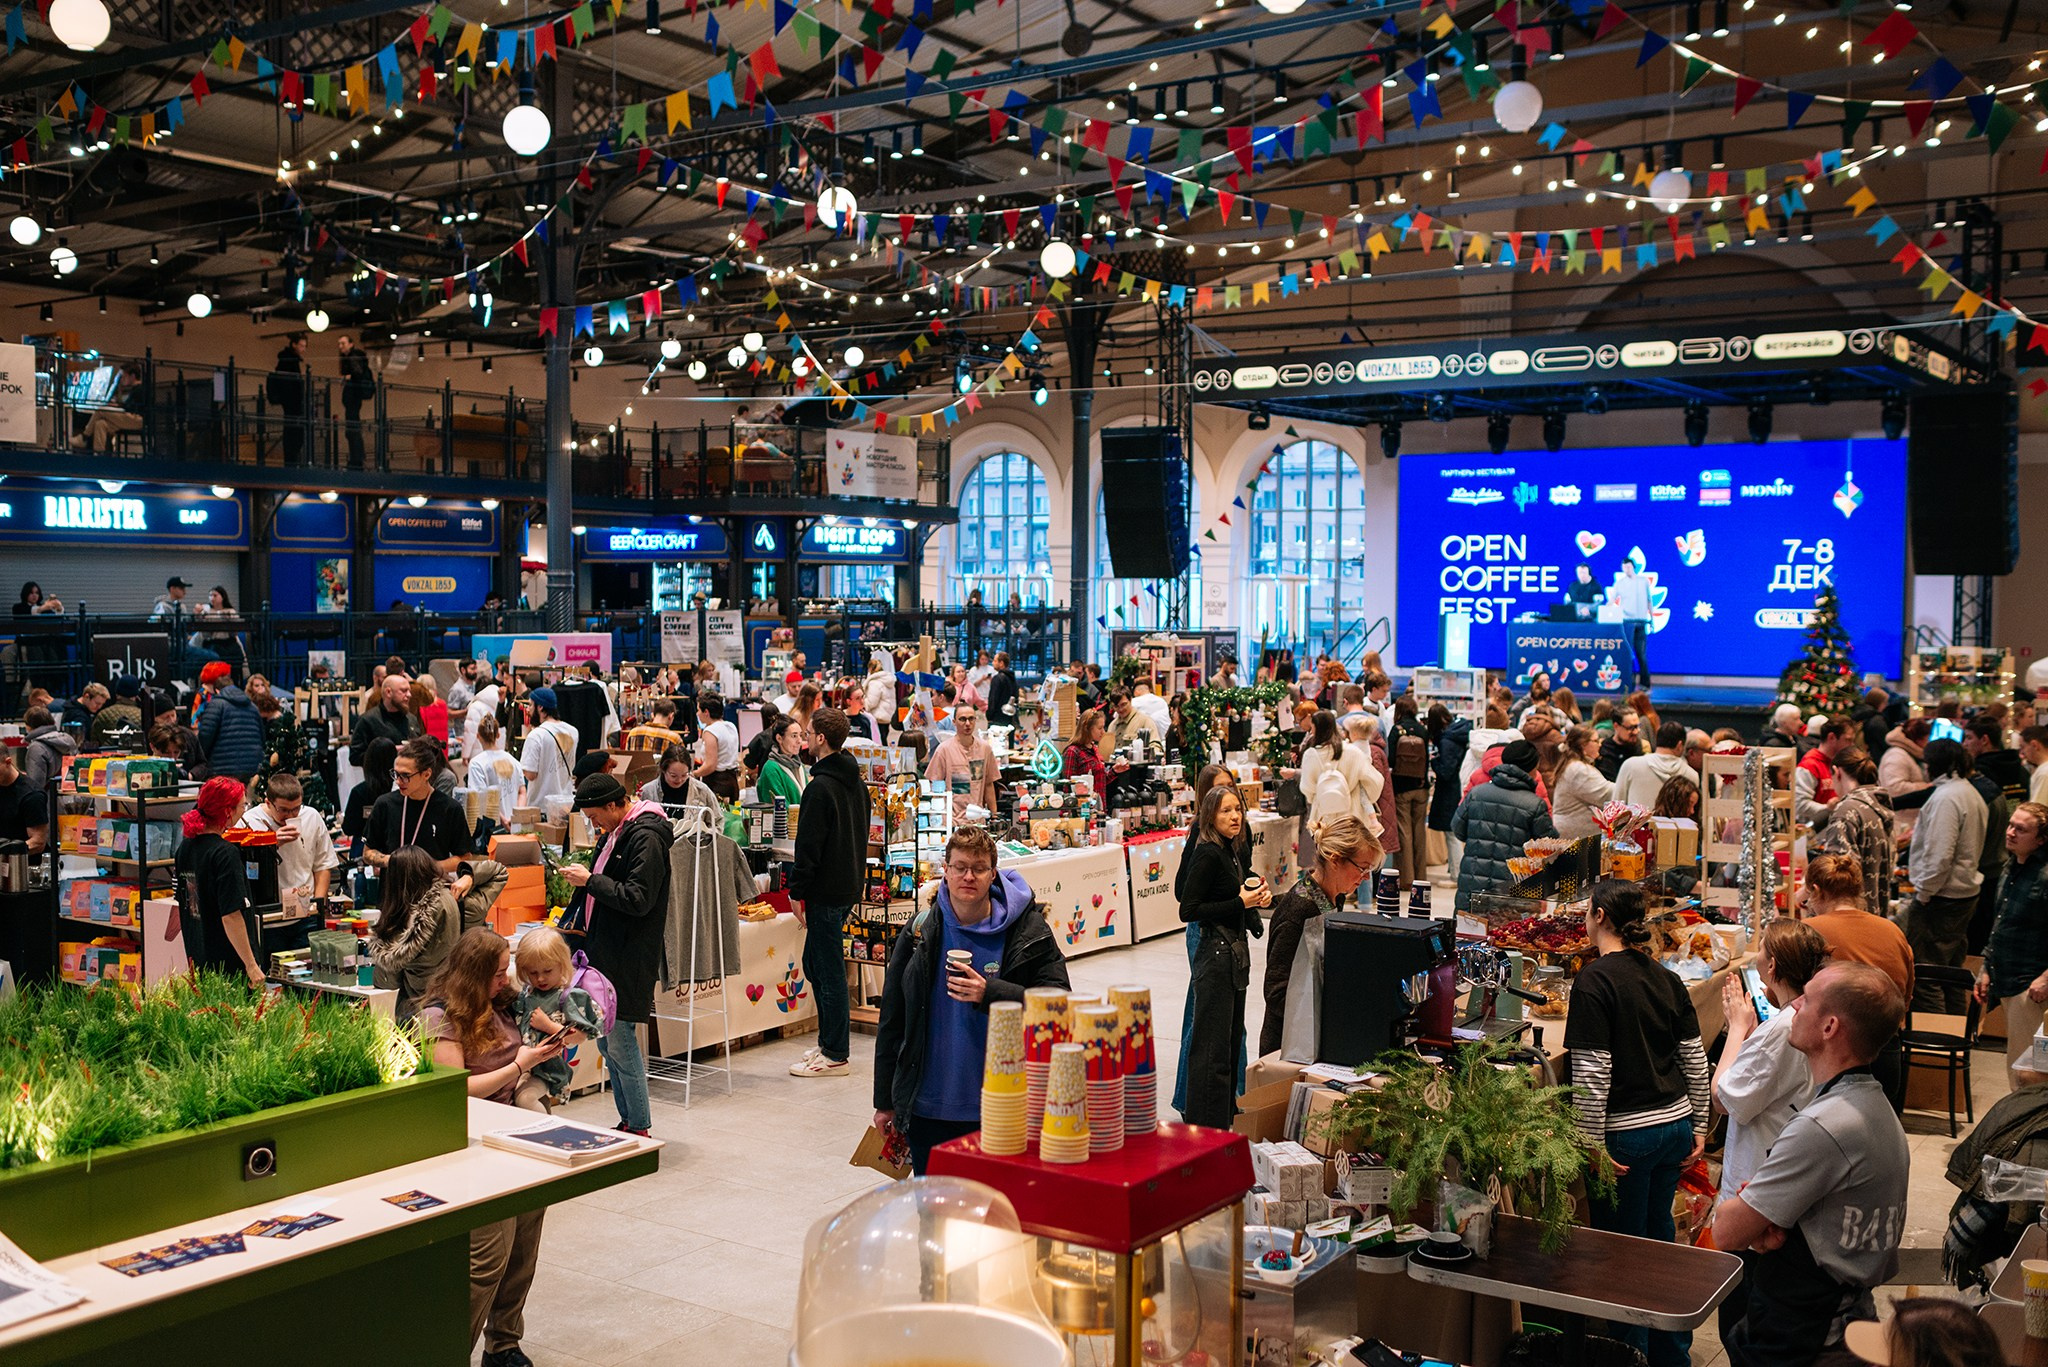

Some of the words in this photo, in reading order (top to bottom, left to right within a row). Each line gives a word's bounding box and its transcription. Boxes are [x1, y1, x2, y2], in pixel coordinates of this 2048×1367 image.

[1242, 373, 1269, 382] отдых
[1363, 362, 1402, 378] VOKZAL
[0, 384, 23, 394] РОК
[1650, 485, 1687, 496] Kitfort
[0, 503, 12, 517] R
[44, 495, 148, 530] BARRISTER
[388, 517, 407, 528] OPEN
[407, 518, 431, 528] COFFEE
[431, 519, 449, 529] FEST
[610, 534, 635, 551] BEER
[663, 534, 698, 550] CRAFT
[814, 526, 856, 545] RIGHT
[859, 528, 896, 547] HOPS
[1440, 534, 1527, 561] OPEN
[1782, 538, 1835, 564] 7-8
[407, 579, 433, 590] VOKZAL
[1440, 565, 1560, 593] COFFEE
[1767, 564, 1834, 593] ДЕК
[664, 615, 682, 623] CITY
[1516, 636, 1548, 648] OPEN
[1549, 637, 1592, 649] COFFEE
[1594, 638, 1623, 650] FEST
[1137, 886, 1156, 899] РАДУГА
[1156, 883, 1170, 895] КОФЕ
